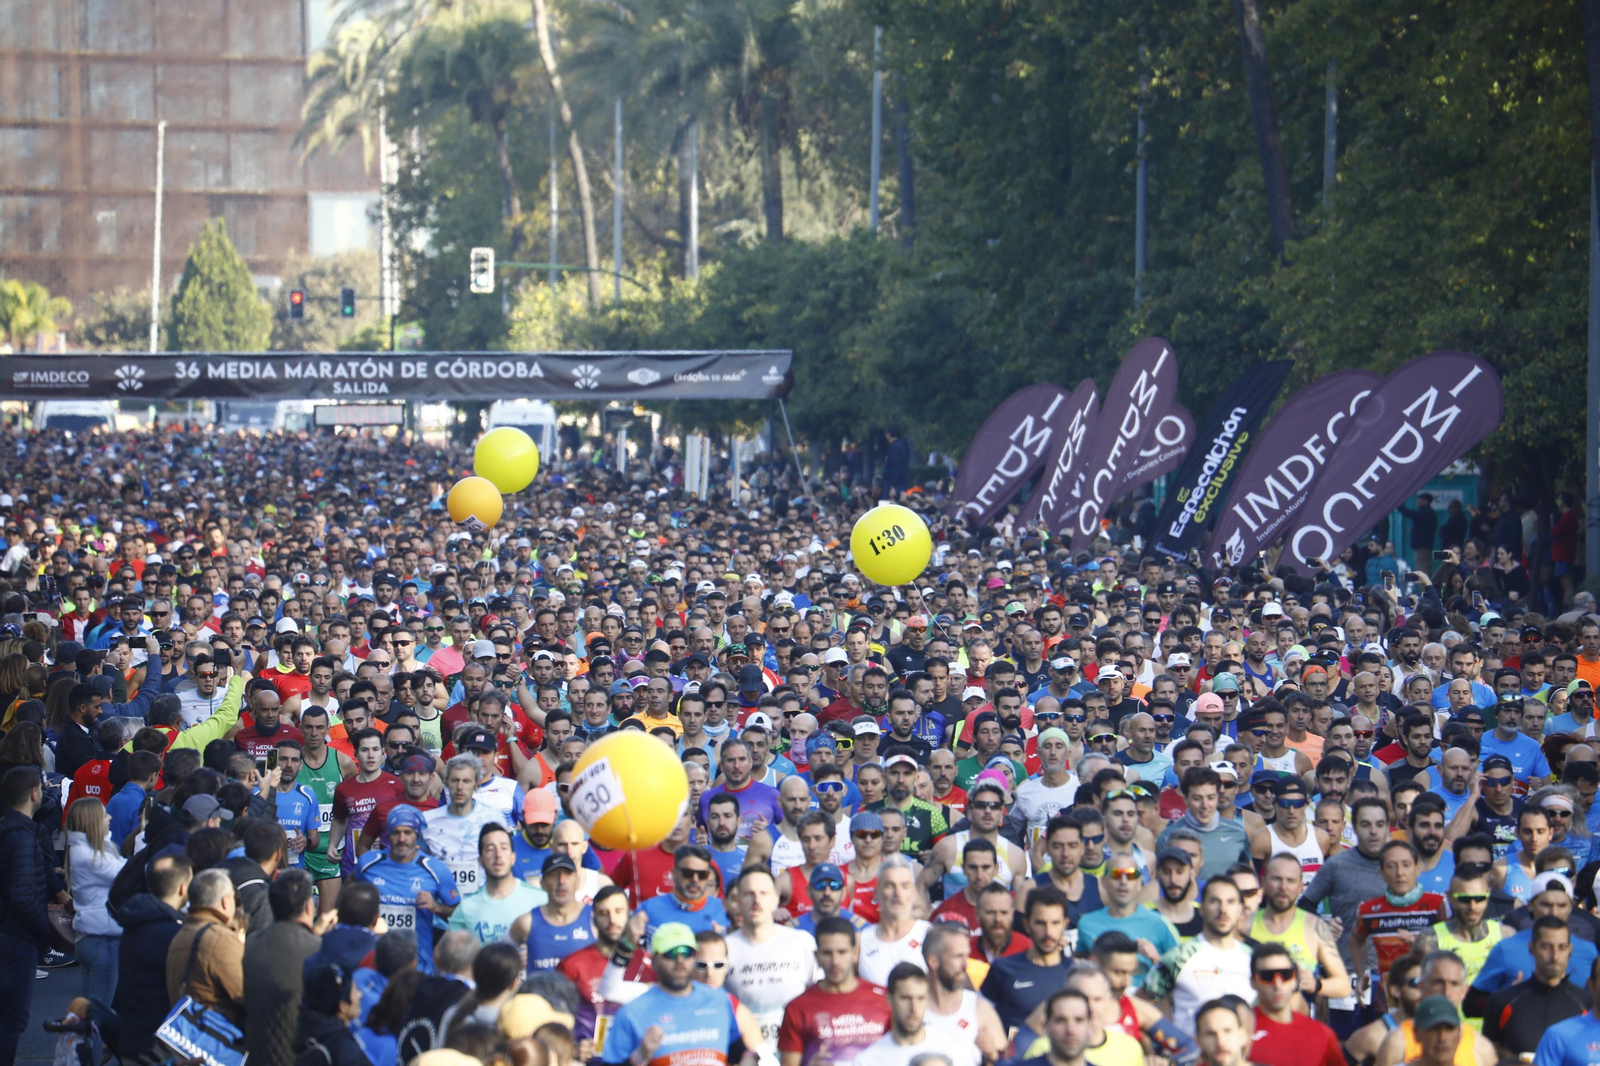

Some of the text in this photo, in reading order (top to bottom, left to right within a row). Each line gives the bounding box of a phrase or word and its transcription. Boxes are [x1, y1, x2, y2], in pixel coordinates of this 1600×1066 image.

[31, 370, 89, 384] IMDECO
[174, 357, 544, 379] 36 MEDIA MARATÓN DE CÓRDOBA
[333, 382, 389, 394] SALIDA
[1168, 406, 1247, 538] Especalchón
[1292, 365, 1482, 565] IMDECO
[1193, 431, 1249, 523] exclusive
[1256, 514, 1286, 542] Instituto
[868, 524, 906, 556] 1:30
[85, 785, 101, 794] UCO
[355, 798, 376, 807] MEDIA
[277, 818, 302, 826] ASIERRA
